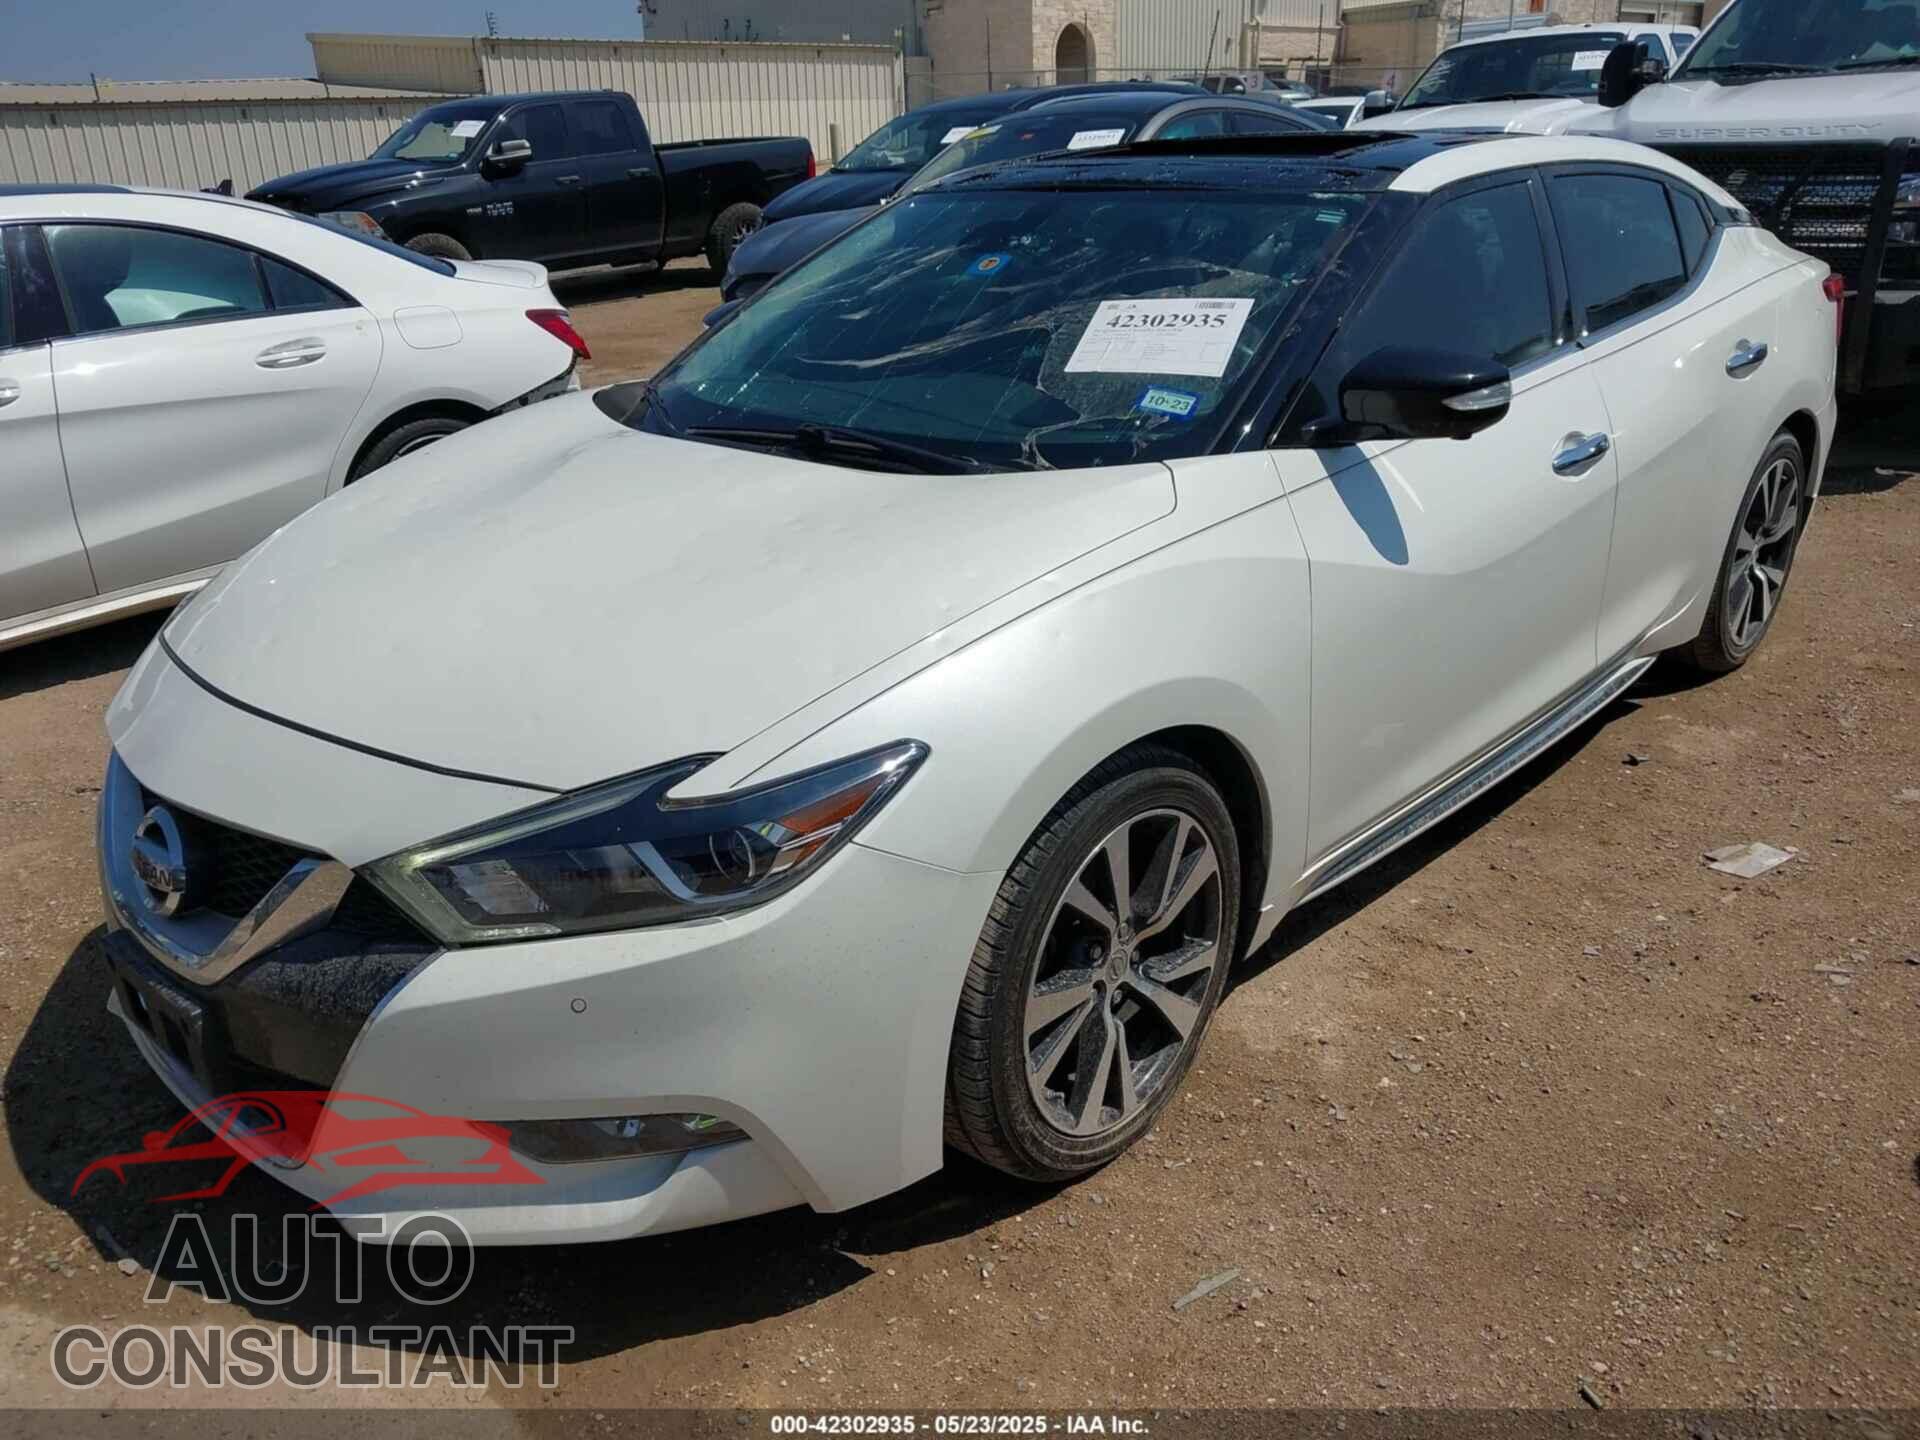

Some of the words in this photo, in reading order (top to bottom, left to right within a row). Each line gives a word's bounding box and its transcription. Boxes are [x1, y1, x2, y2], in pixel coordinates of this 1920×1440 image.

[1656, 127, 1771, 139] SUPER
[1776, 122, 1883, 137] DUTY
[1107, 313, 1228, 328] 42302935
